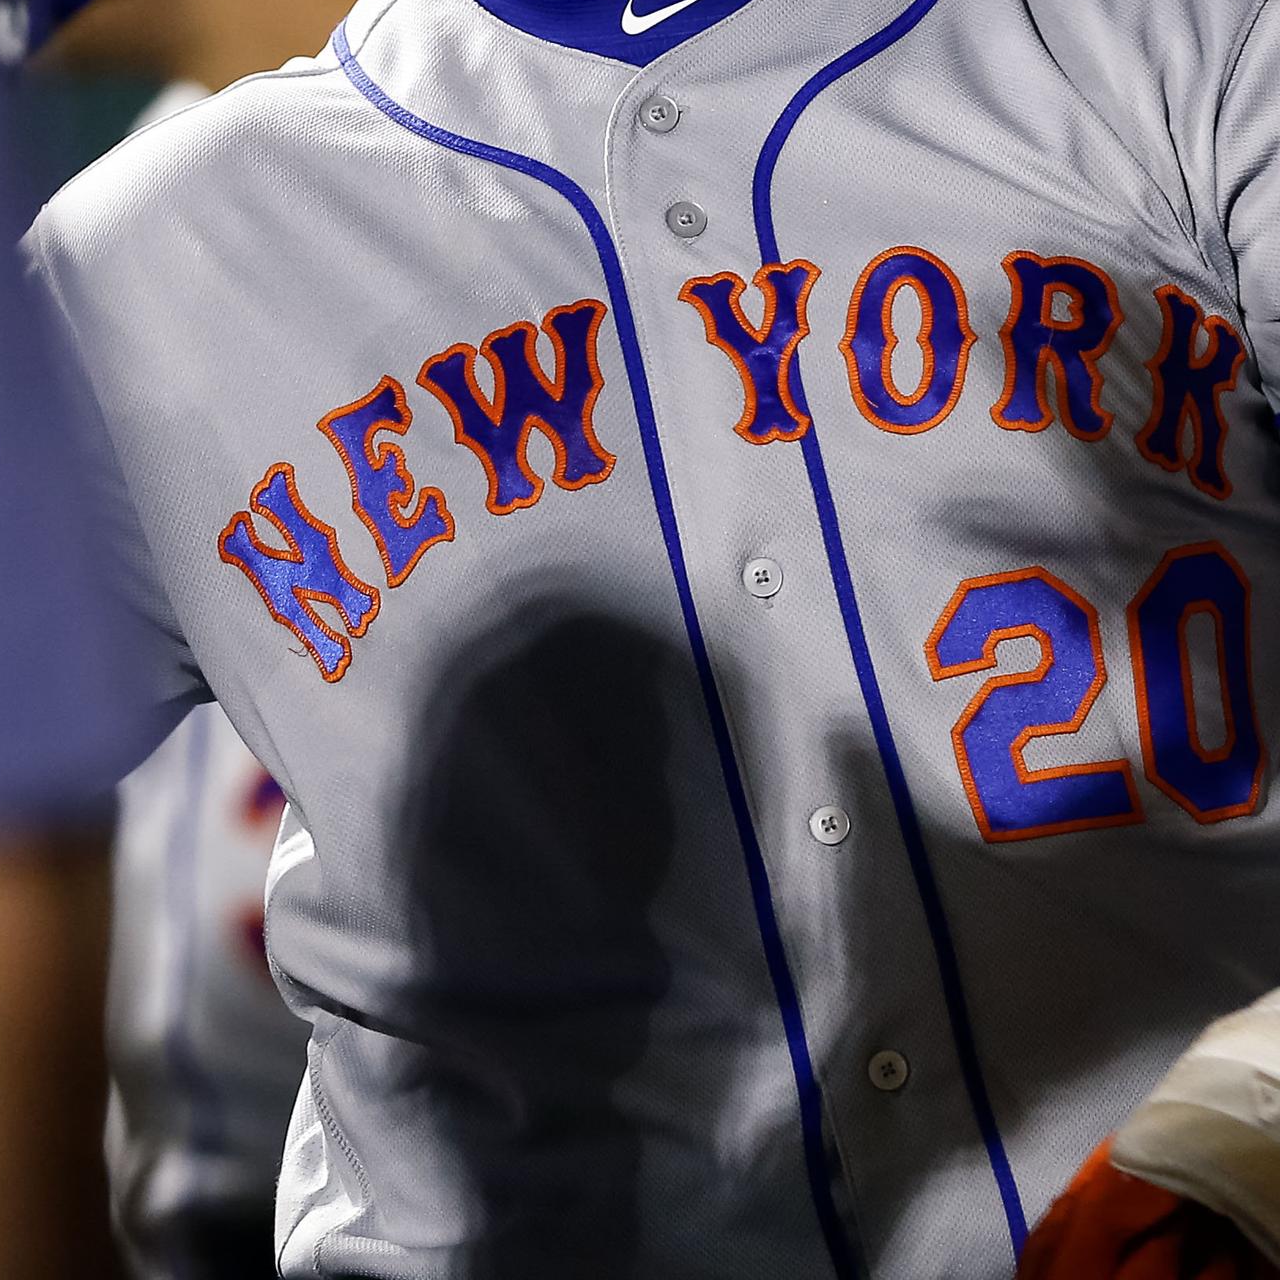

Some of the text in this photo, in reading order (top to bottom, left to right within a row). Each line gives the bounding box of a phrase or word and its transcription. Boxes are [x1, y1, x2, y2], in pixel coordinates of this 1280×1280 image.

[218, 245, 1246, 683] NEW YORK
[926, 540, 1267, 843] 20
